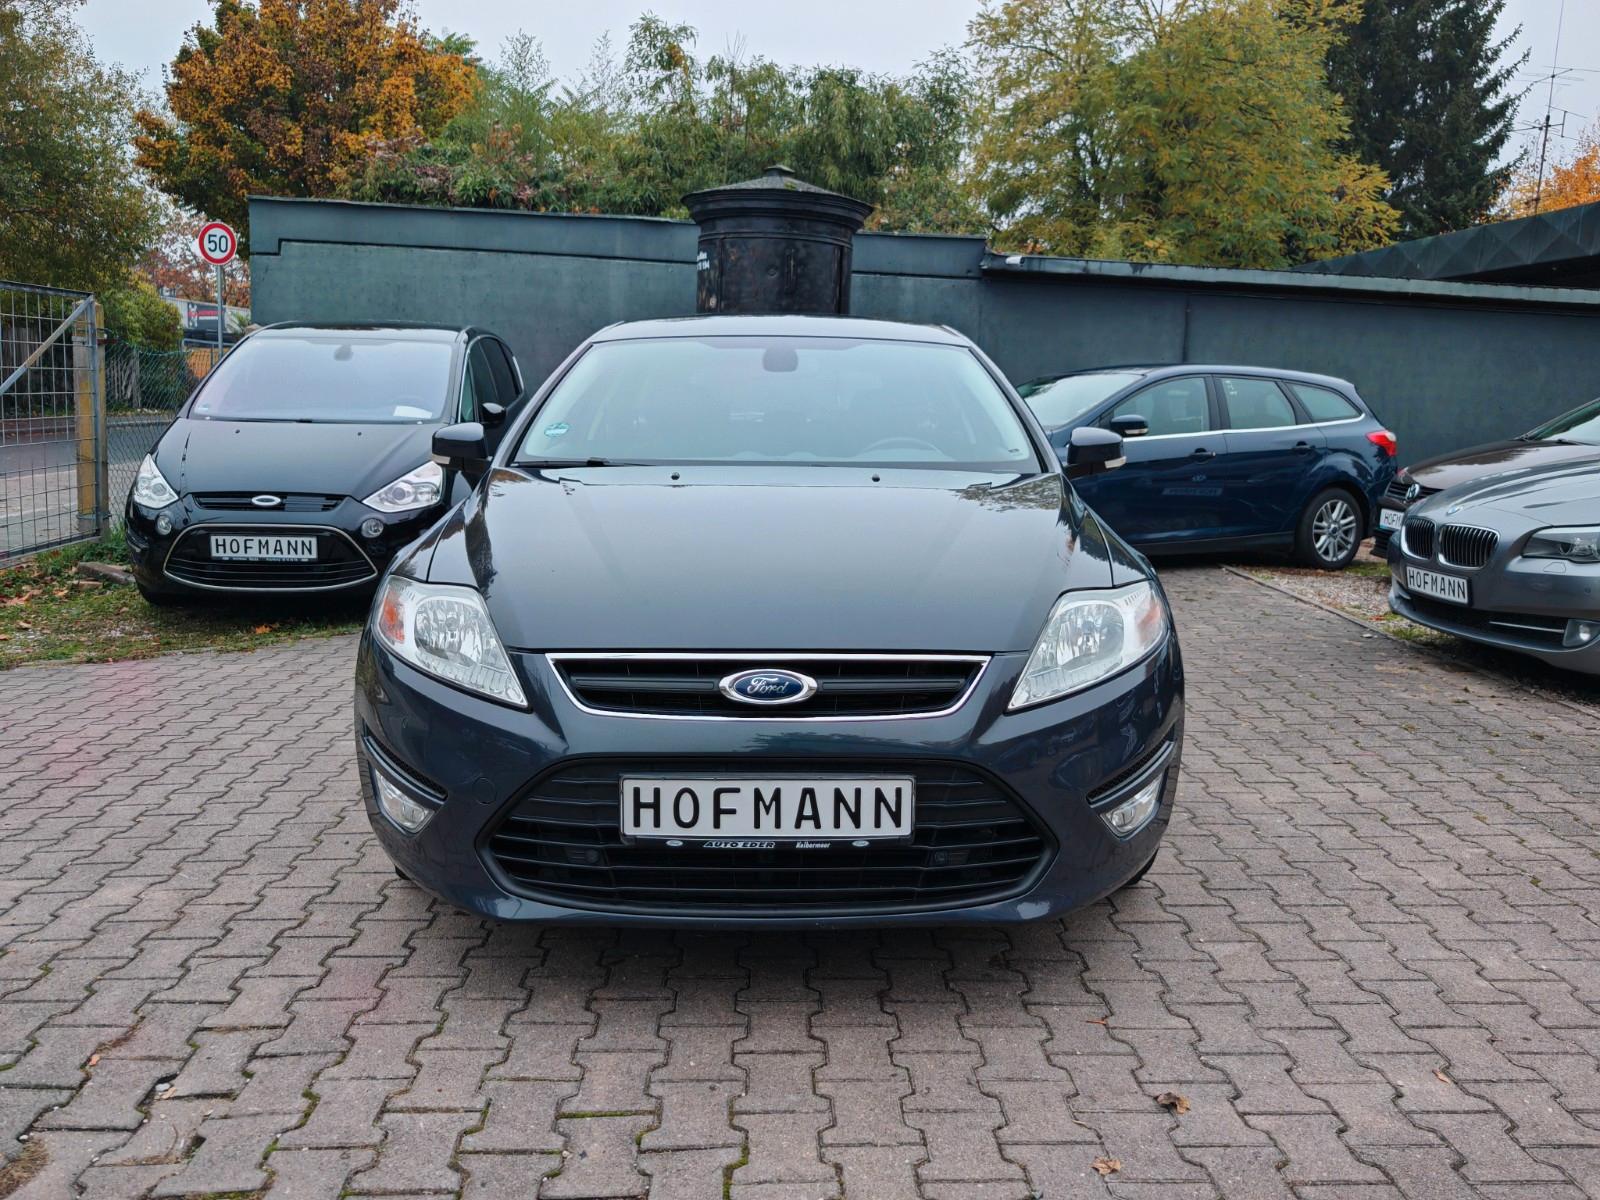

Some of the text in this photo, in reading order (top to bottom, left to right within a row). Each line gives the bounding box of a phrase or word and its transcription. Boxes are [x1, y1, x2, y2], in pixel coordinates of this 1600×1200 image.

[208, 234, 228, 252] 50
[215, 537, 313, 556] HOFMANN
[1408, 569, 1466, 599] HOFMANN
[747, 676, 790, 694] Ford
[632, 786, 903, 830] HOFMANN
[703, 841, 776, 849] AUTO EDER
